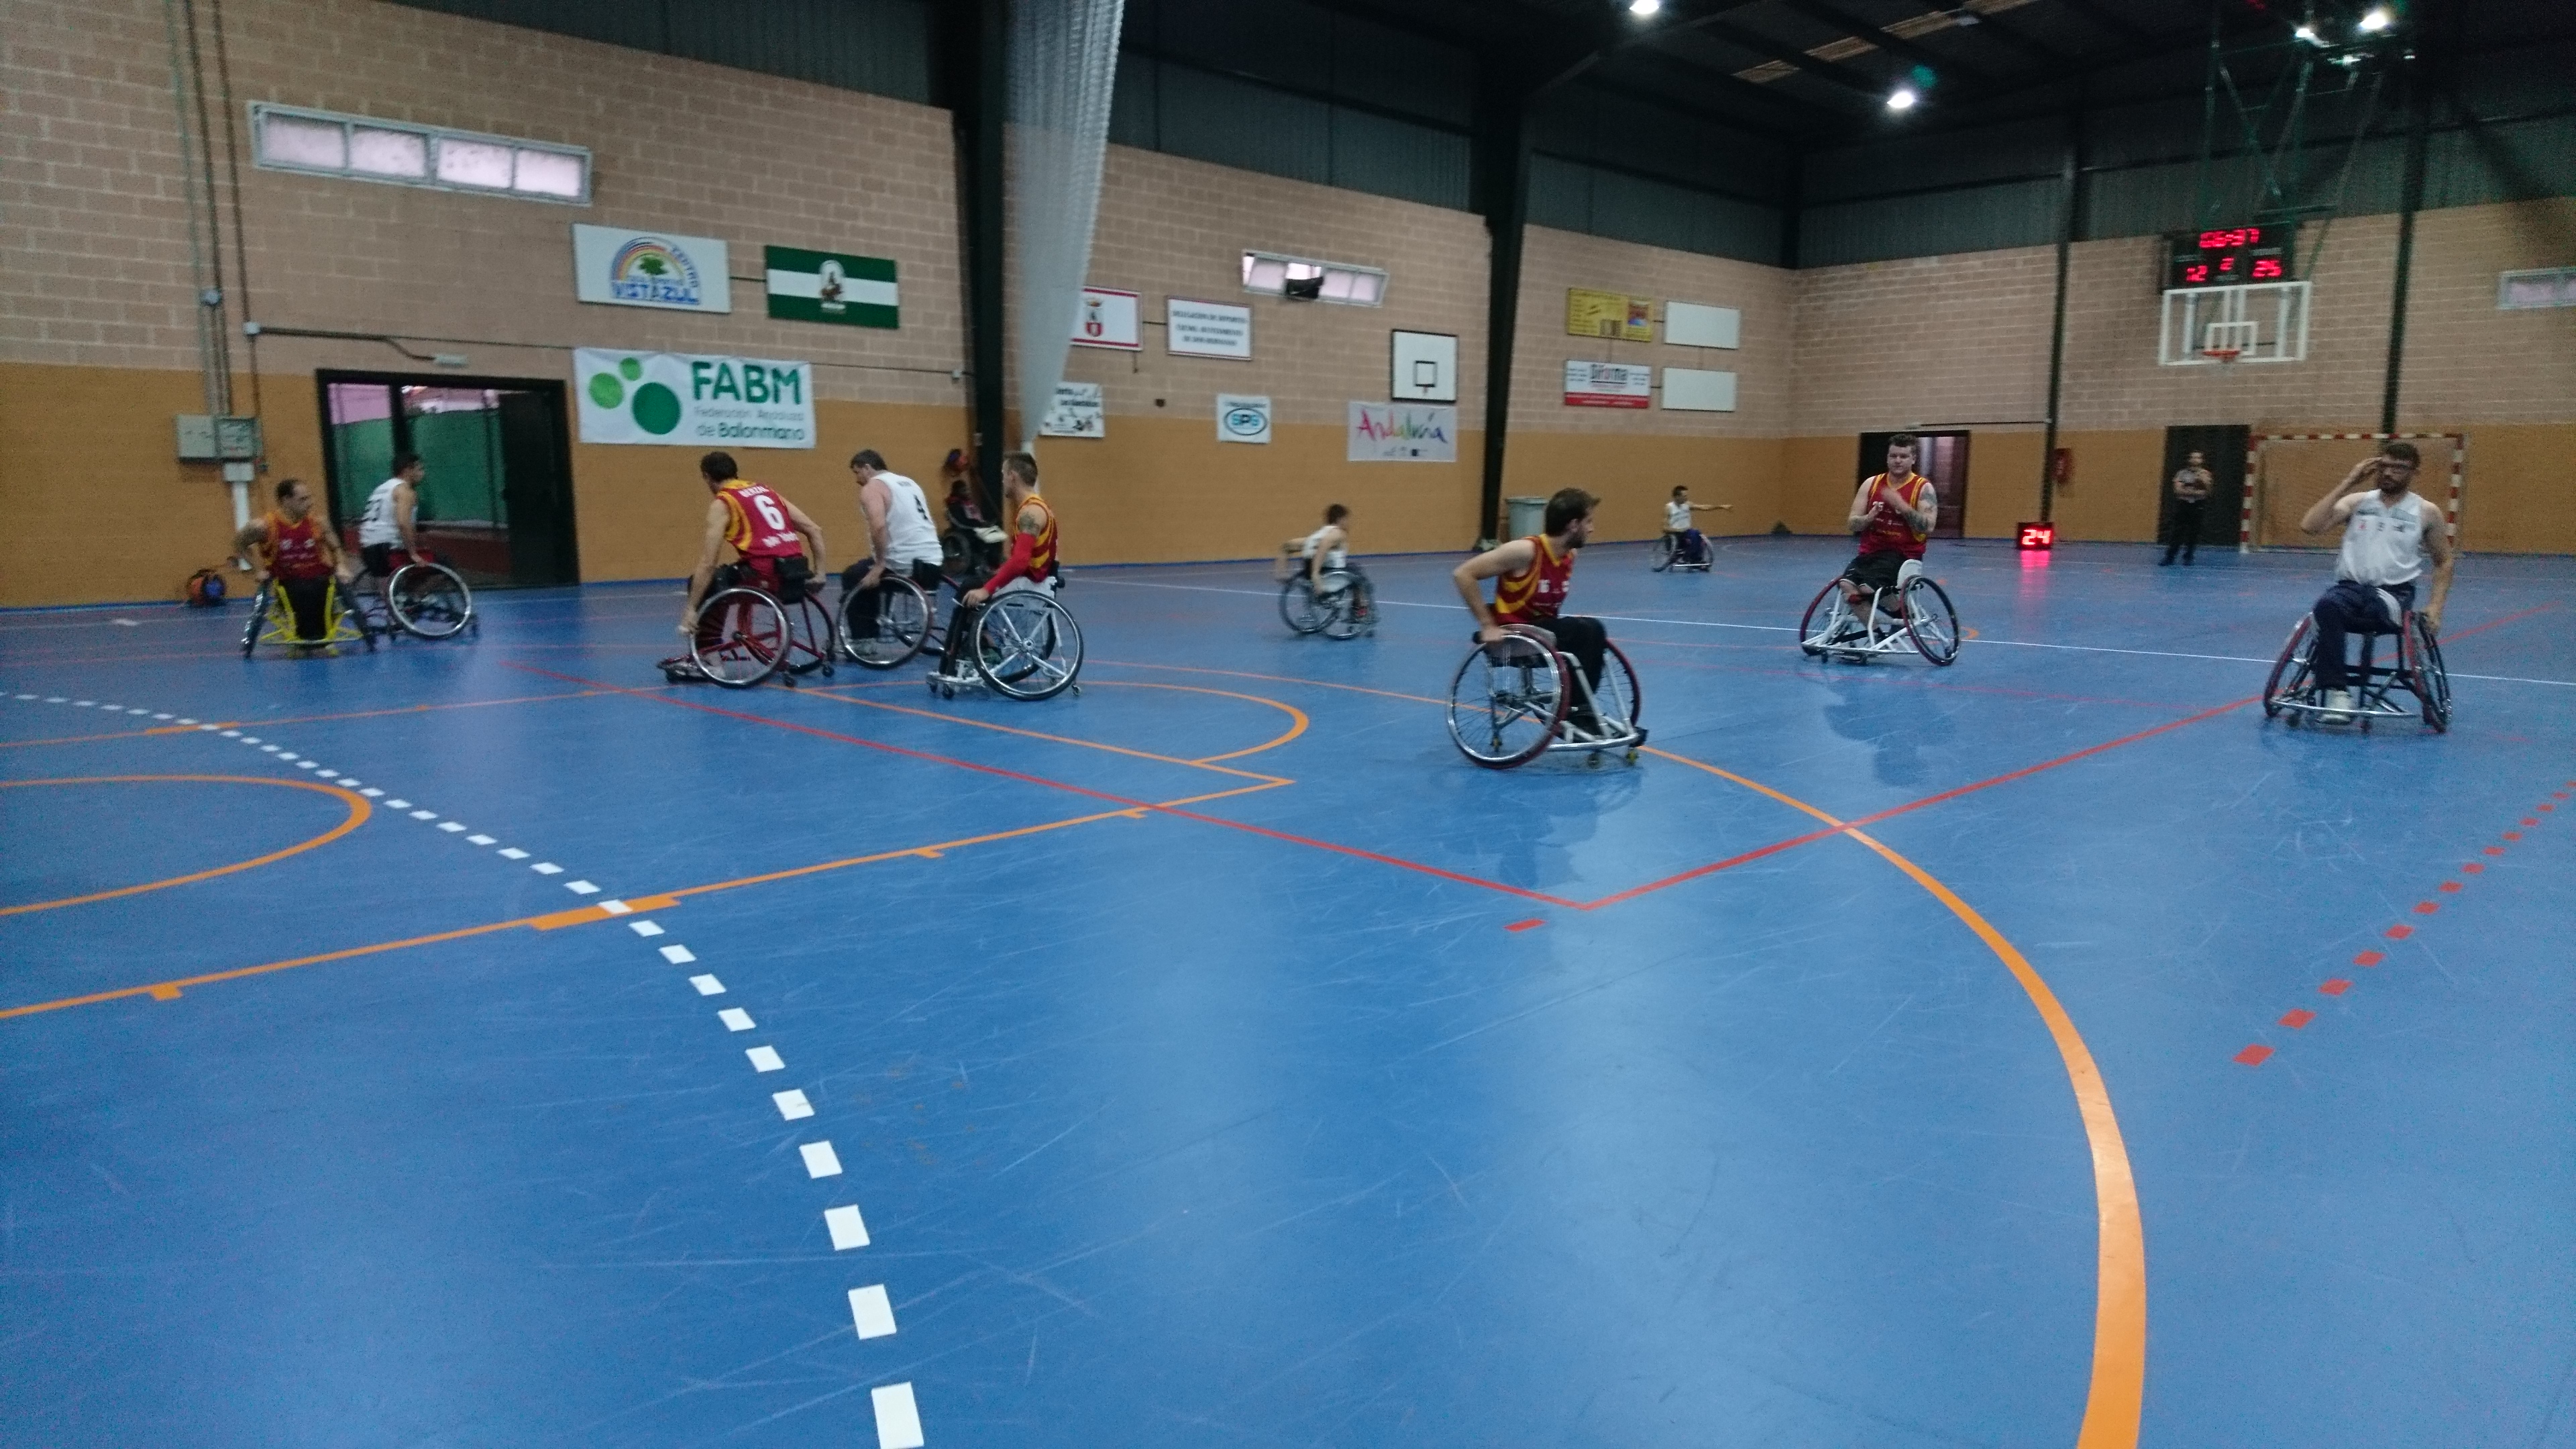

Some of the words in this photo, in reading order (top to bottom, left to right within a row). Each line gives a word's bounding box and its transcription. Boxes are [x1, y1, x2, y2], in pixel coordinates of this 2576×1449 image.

[691, 361, 801, 405] FABM
[718, 421, 804, 440] Balonmano
[753, 494, 785, 530] 6
[2021, 528, 2051, 545] 24
